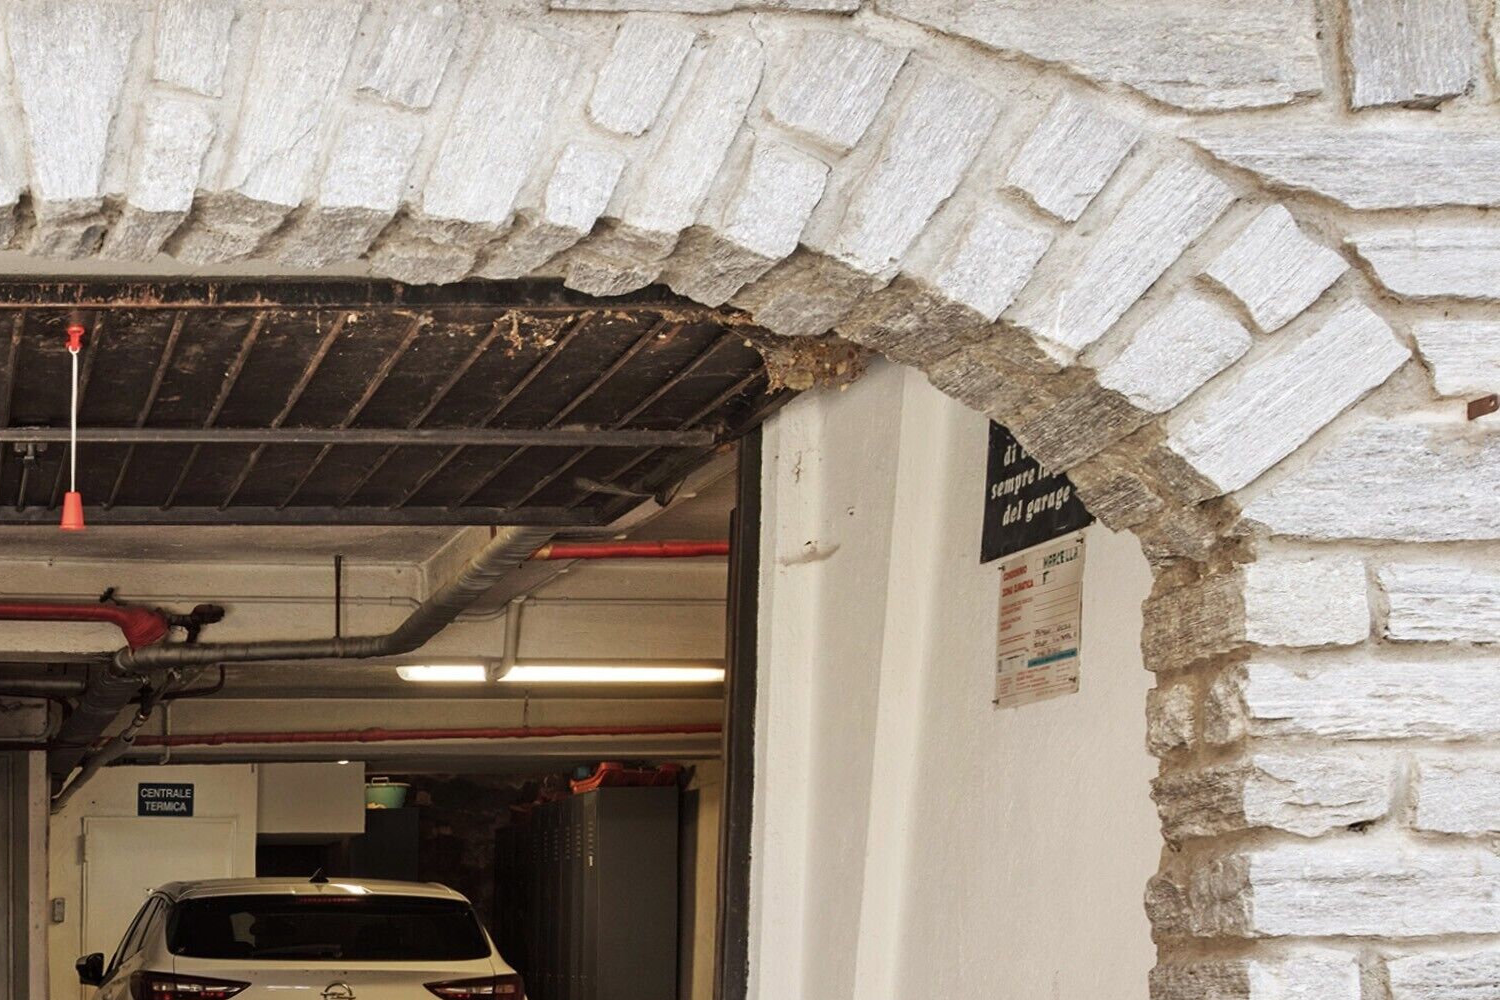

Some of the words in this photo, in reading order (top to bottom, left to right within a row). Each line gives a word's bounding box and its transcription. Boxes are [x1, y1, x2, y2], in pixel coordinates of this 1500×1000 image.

[1003, 443, 1017, 467] di
[991, 467, 1035, 500] sempre
[1002, 500, 1024, 527] del
[1025, 485, 1071, 523] garage
[140, 788, 192, 798] CENTRALE
[144, 801, 187, 812] TERMICA
